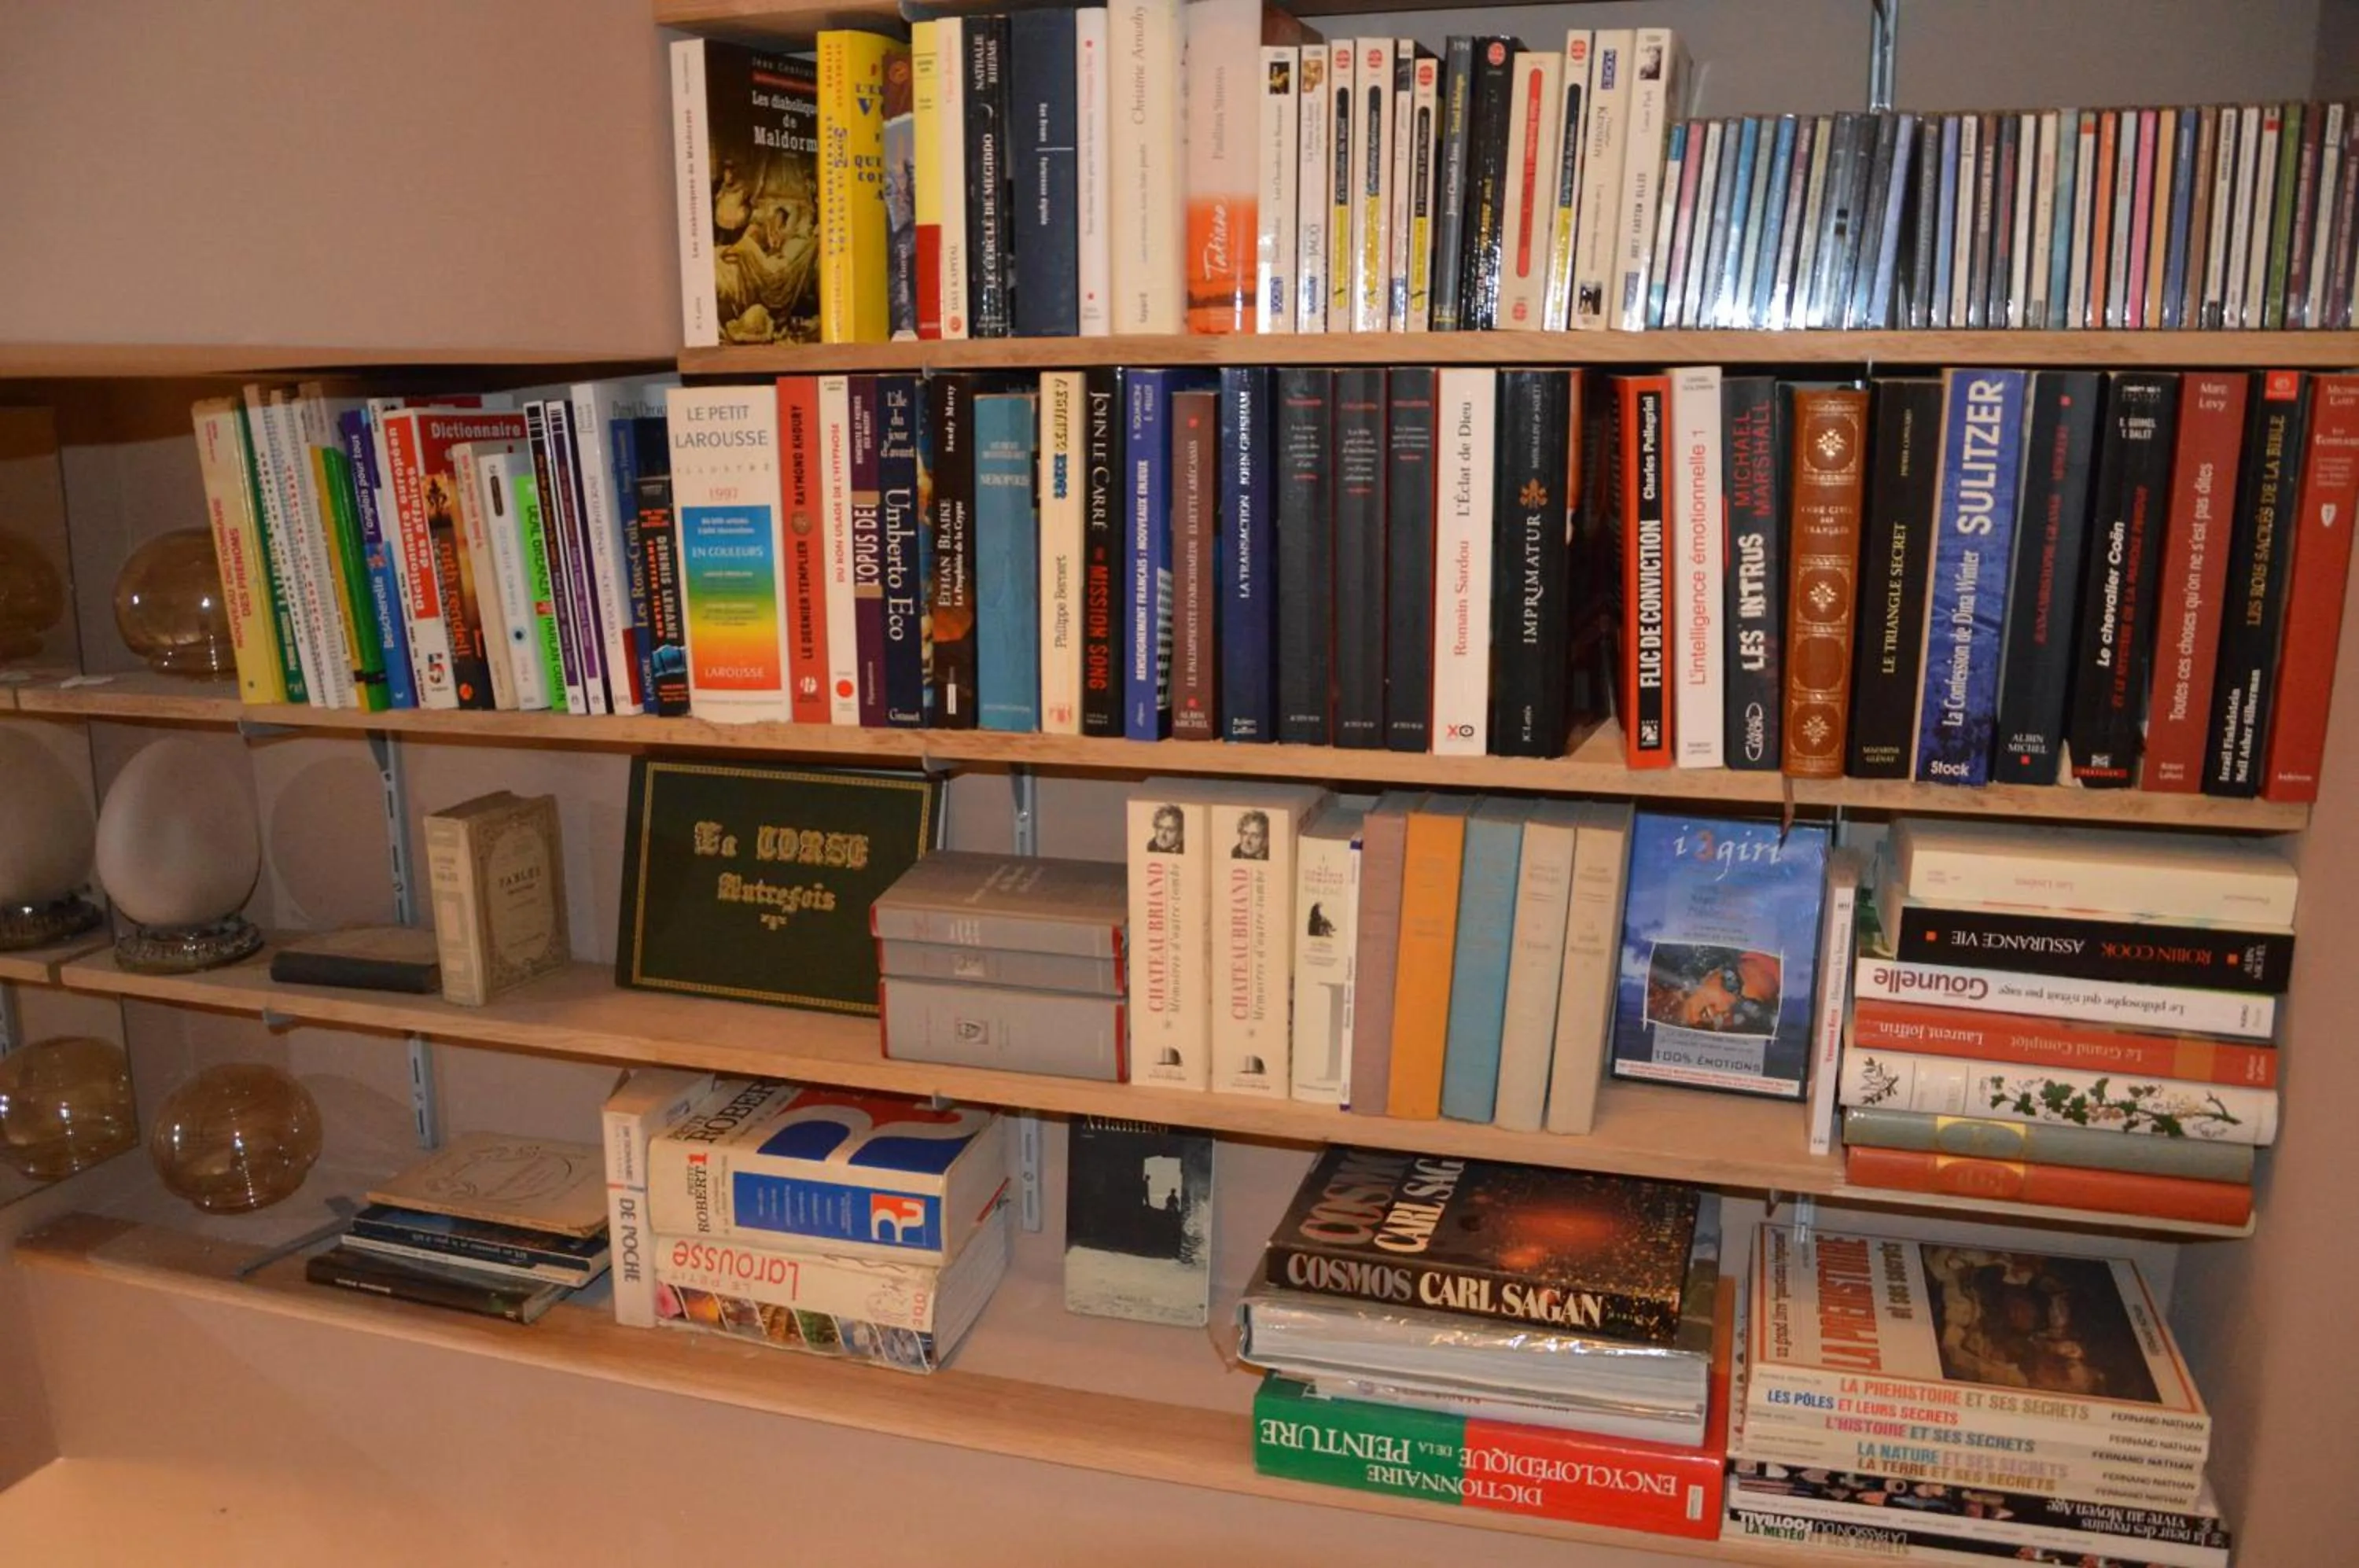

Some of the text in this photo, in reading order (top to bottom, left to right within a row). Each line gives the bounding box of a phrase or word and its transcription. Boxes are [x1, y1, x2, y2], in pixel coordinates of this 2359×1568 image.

[973, 34, 985, 91] NATHALIE
[987, 39, 998, 84] RHEIMS
[752, 90, 770, 109] Les
[782, 115, 797, 129] de
[1039, 102, 1049, 142] Dan Brown
[1131, 64, 1146, 125] Christine
[984, 196, 995, 216] DE
[1038, 157, 1050, 226] Forteresse digitale
[1635, 172, 1647, 198] ELLIS
[984, 219, 996, 271] CERCLE
[1632, 202, 1643, 234] EASTON
[985, 271, 997, 289] LE
[430, 421, 521, 439] Dictionnaire
[686, 404, 749, 421] LE PETIT
[1090, 392, 1111, 438] JOHN
[2198, 396, 2227, 412] Levy
[351, 434, 370, 486] pour tous
[675, 429, 769, 449] LAROUSSE
[790, 404, 806, 506] RAYMOND KHOURY
[1732, 410, 1751, 507] MICHAEL
[1752, 399, 1772, 518] MARSHALL
[389, 427, 425, 612] Dictionnaire européen
[407, 466, 429, 569] des affaires
[834, 502, 843, 537] USAGE
[1238, 392, 1251, 598] LA TRANSACTION JOHN GRISHAM
[2246, 414, 2285, 626] LES ROIS SACRÉS DE LA BIBLE
[854, 503, 881, 587] L'OPUS DEI
[1453, 401, 1472, 657] Romain Sardou L'Éclat de Dieu
[1640, 396, 1662, 688] FLIC DE CONVICTION Charles Pellegrini
[1941, 379, 2005, 727] La Confession de Dina Winter SULITZER
[656, 535, 678, 639] DENNIS LEHANE
[885, 488, 915, 642] Umberto Eco
[1689, 444, 1710, 686] L'intelligence émotionnelle
[2168, 462, 2214, 721] Toutes ces choses qu'on ne s'est pas dites
[373, 576, 395, 649] Bescherelle
[440, 543, 471, 655] ruth rendell
[635, 602, 649, 627] Les
[1738, 532, 1766, 671] LES INTRUS
[1882, 521, 1907, 674] LE TRIANGLE SECRET
[2096, 521, 2125, 667] Le chevalier Coën
[1088, 565, 1109, 690] MISSION SONG
[705, 666, 765, 679] LAROUSSE
[2236, 668, 2261, 783] Neil Asher Silberman
[1930, 760, 1971, 776] Stock
[694, 821, 870, 870] La CORSE
[716, 871, 837, 911] Autrefois
[1146, 862, 1165, 1013] CHATEAUBRIAND
[1229, 869, 1249, 1021] CHATEAUBRIAND
[1951, 930, 2213, 966] ROBIN COOK ASSURANCE VIE
[1873, 967, 1990, 1001] Gounelle
[1998, 983, 2185, 1016] Le philosophe qui n'était pas sage
[1652, 1048, 1761, 1073] 100% ÉMOTIONS
[1879, 1018, 2143, 1062] Le Grand Complot Laurent Joffrin
[619, 1197, 636, 1221] DE
[686, 1153, 711, 1233] ROBERT 1
[620, 1225, 641, 1283] POCHE
[672, 1239, 801, 1301] Larousse
[1286, 1252, 1605, 1328] COSMOS CARL SAGAN
[1767, 1389, 2158, 1448] LES PÔLES ET LEURS SECRETS FERNAND
[1840, 1377, 2205, 1431] LA PREHISTOIRE ET SES SECRETS FERNAND NATHAN
[1260, 1418, 1678, 1496] ENCYCLOPÉDIQUE PEINTURE
[1824, 1415, 2036, 1453] L'HISTOIRE ET SES SECRETS
[1857, 1441, 2070, 1478] LA NATURE SECRETS
[1366, 1462, 1543, 1507] DICTIONNAIRE
[1857, 1456, 2055, 1492] LA TERRE SECRETS
[1737, 1511, 1888, 1541] PASSION DU FOOTBALL
